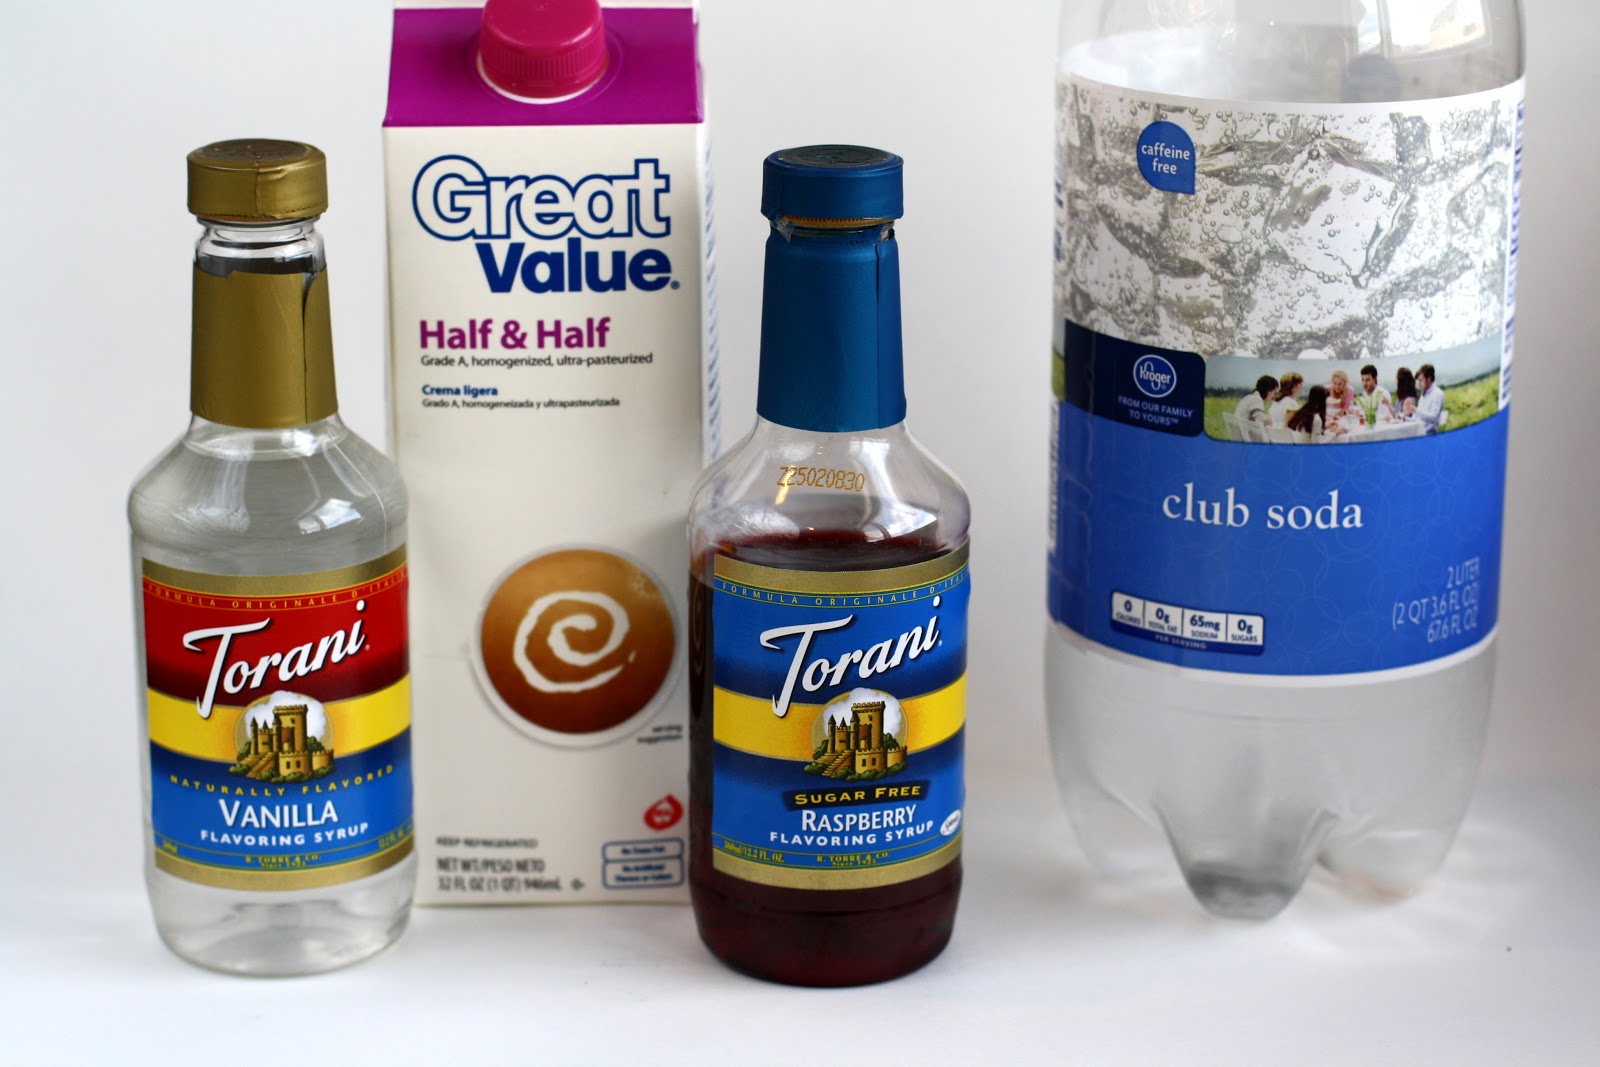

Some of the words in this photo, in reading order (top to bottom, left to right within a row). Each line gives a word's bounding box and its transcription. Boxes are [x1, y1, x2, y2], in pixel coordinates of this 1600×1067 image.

[1141, 142, 1190, 160] caffeine
[1152, 158, 1177, 174] free
[412, 154, 671, 241] Great
[419, 318, 493, 350] Half
[500, 320, 527, 349] &
[536, 316, 610, 349] Half
[421, 355, 455, 367] Grade
[458, 356, 468, 367] A,
[471, 355, 554, 369] homogenized,
[556, 353, 653, 368] ultra-pasteurized
[1139, 361, 1171, 391] Kroger
[421, 384, 461, 396] Crema
[463, 384, 498, 398] ligera
[422, 399, 450, 408] Grado
[462, 398, 534, 410] homogeneizada
[536, 401, 542, 410] y
[543, 397, 620, 409] ultrapasteurizada
[1118, 395, 1140, 408] FROM
[1141, 401, 1160, 412] OUR
[1161, 405, 1193, 418] FAMILY
[1129, 409, 1140, 420] TO
[1162, 481, 1250, 528] club
[1266, 489, 1364, 530] soda
[1447, 566, 1454, 588] 2
[1455, 556, 1480, 586] LITER
[148, 584, 216, 607] FORMULA
[232, 593, 337, 609] ORIGINALE
[722, 582, 798, 604] FORMULA
[815, 590, 917, 606] ORIGINALE
[1123, 599, 1133, 613] 0
[1155, 607, 1170, 624] 0g
[1408, 597, 1429, 625] QT
[1449, 590, 1461, 612] FL
[1148, 620, 1165, 632] TOTAL
[1167, 624, 1178, 633] FAT
[1189, 614, 1220, 631] 65mg
[1237, 619, 1253, 634] 0g
[1451, 613, 1462, 635] FL
[1155, 634, 1169, 643] PER
[1172, 637, 1207, 650] SERVING
[1191, 630, 1218, 640] SODIUM
[1231, 634, 1258, 643] SUGARS
[182, 599, 366, 719] Torani
[759, 595, 940, 718] Torani
[170, 774, 285, 796] NATURALLY
[302, 764, 394, 795] FLAVORED
[794, 790, 865, 805] SUGAR
[874, 785, 921, 799] FREE
[218, 798, 339, 829] VANILLA
[801, 804, 917, 833] RASPBERRY
[200, 829, 305, 847] FLAVORING
[313, 822, 369, 844] SYRUP
[769, 831, 877, 847] FLAVORING
[885, 819, 934, 842] SYRUP
[436, 857, 458, 872] NET
[515, 858, 545, 873] NETO
[454, 876, 466, 891] FL
[469, 876, 484, 891] OZ
